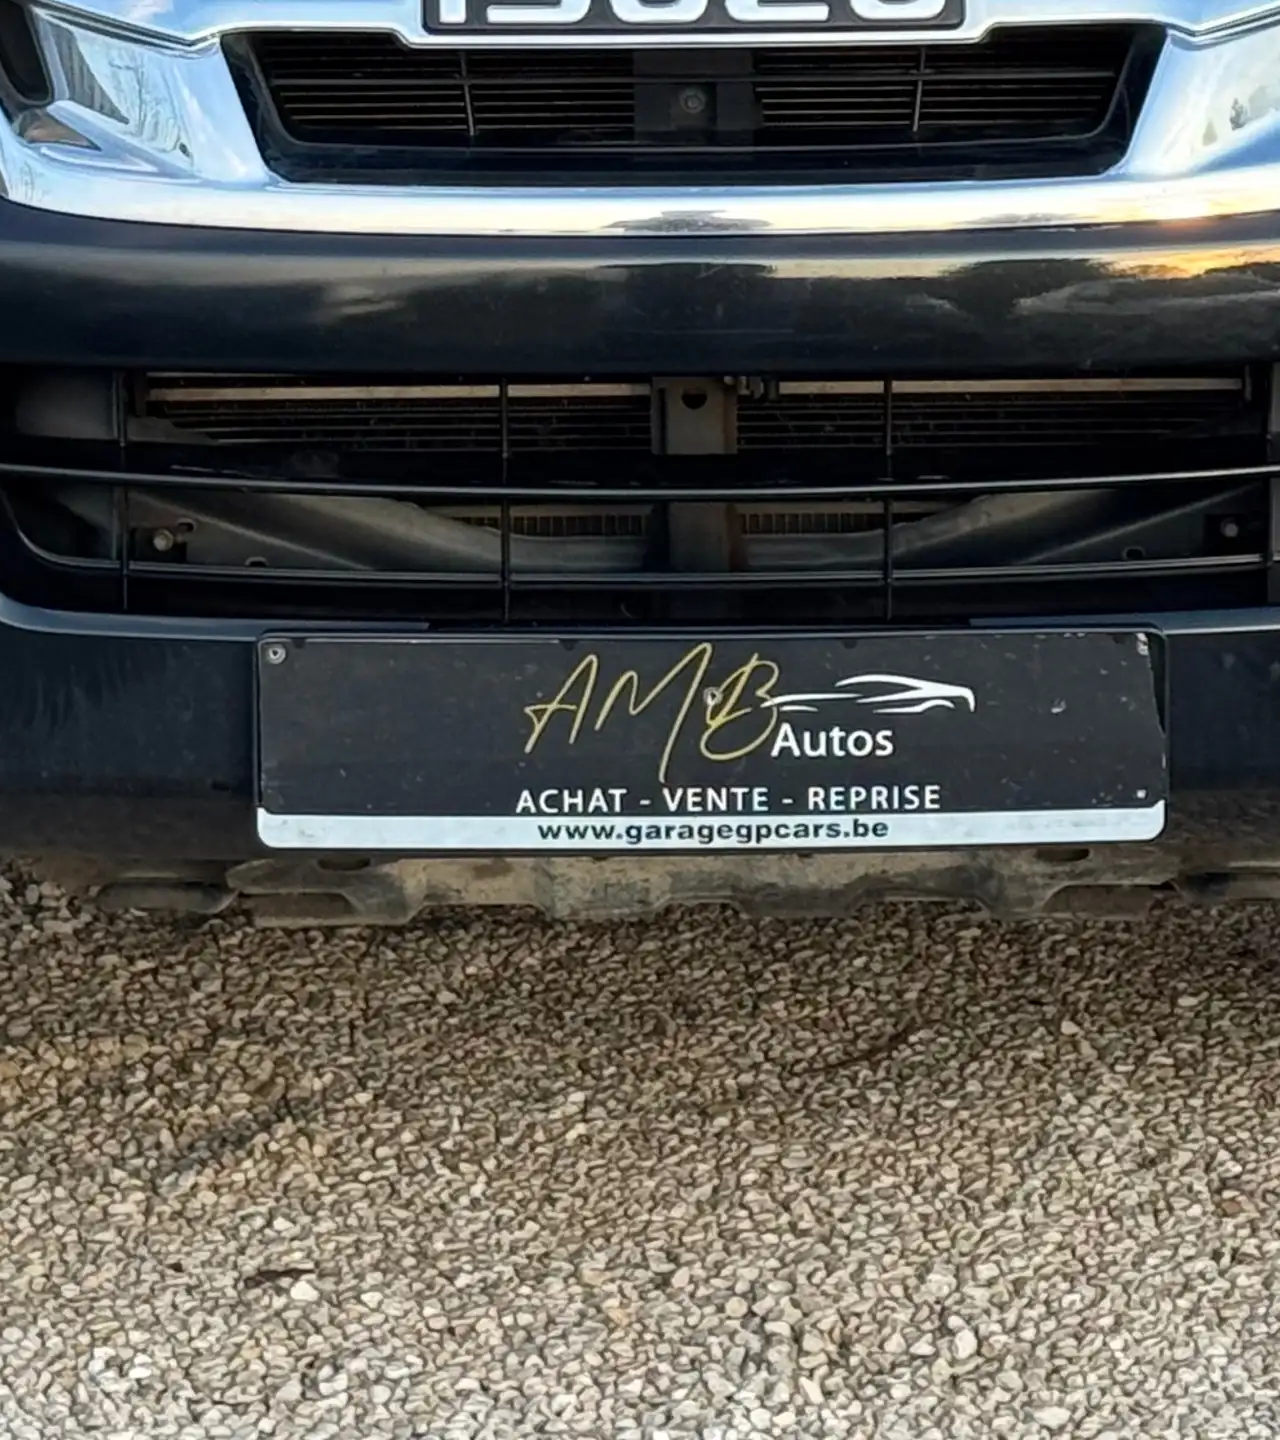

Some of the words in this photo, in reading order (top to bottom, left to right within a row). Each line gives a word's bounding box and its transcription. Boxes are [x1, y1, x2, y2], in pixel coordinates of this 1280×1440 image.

[770, 722, 894, 757] Autos
[516, 788, 628, 814] ACHAT
[662, 787, 769, 812] VENTE
[807, 784, 941, 811] REPRISE
[537, 818, 889, 845] www.garagegpcars.be
